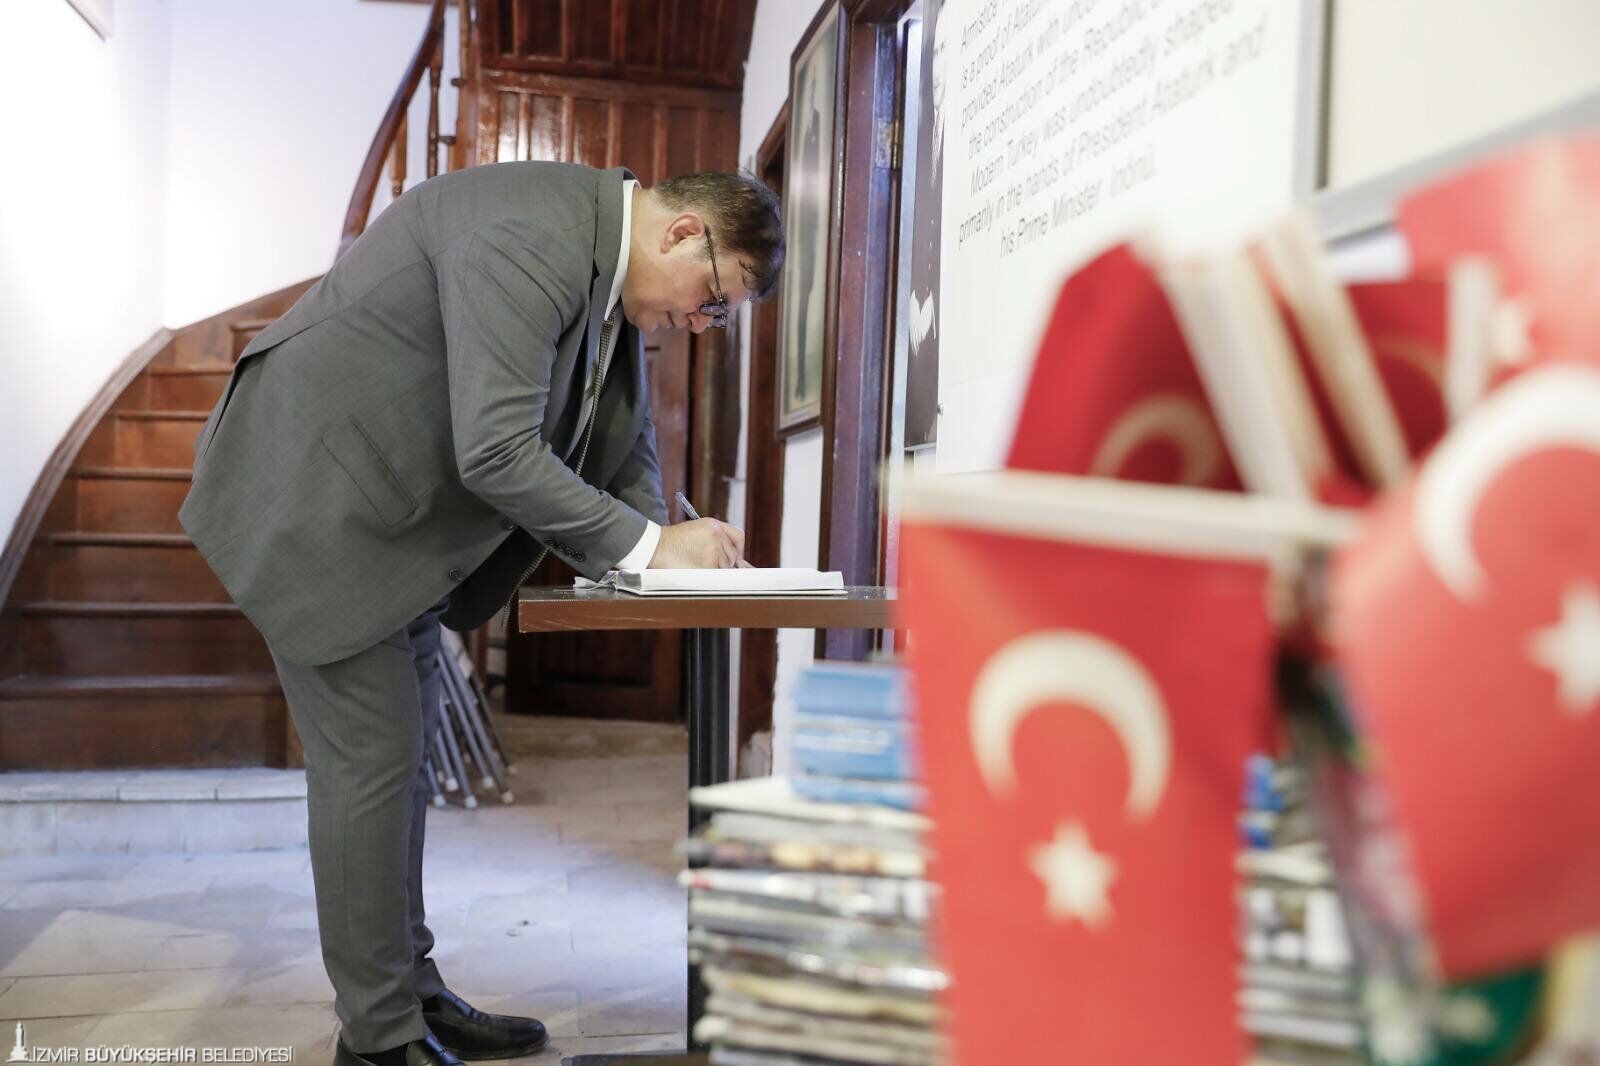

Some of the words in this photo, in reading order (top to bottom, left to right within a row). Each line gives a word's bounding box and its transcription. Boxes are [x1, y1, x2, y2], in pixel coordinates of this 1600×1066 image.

[961, 66, 969, 92] is
[970, 61, 976, 83] a
[976, 25, 1001, 82] proof
[1002, 14, 1013, 49] of
[959, 198, 994, 252] primarily
[995, 193, 1005, 219] in
[1007, 183, 1022, 213] the
[1024, 158, 1060, 201] hands
[1062, 138, 1078, 177] of
[1076, 97, 1148, 168] President
[1222, 12, 1268, 78] and
[961, 71, 1000, 136] provided
[969, 131, 982, 160] the
[982, 80, 1042, 149] construction
[1045, 57, 1058, 97] of
[1059, 49, 1079, 85] the
[970, 155, 1004, 198] Modern
[1007, 130, 1040, 169] Turkey
[1042, 106, 1066, 144] was
[1069, 35, 1156, 124] undoubtedly
[1000, 226, 1015, 259] his
[1017, 212, 1049, 249] Prime
[1051, 178, 1103, 231] Minister
